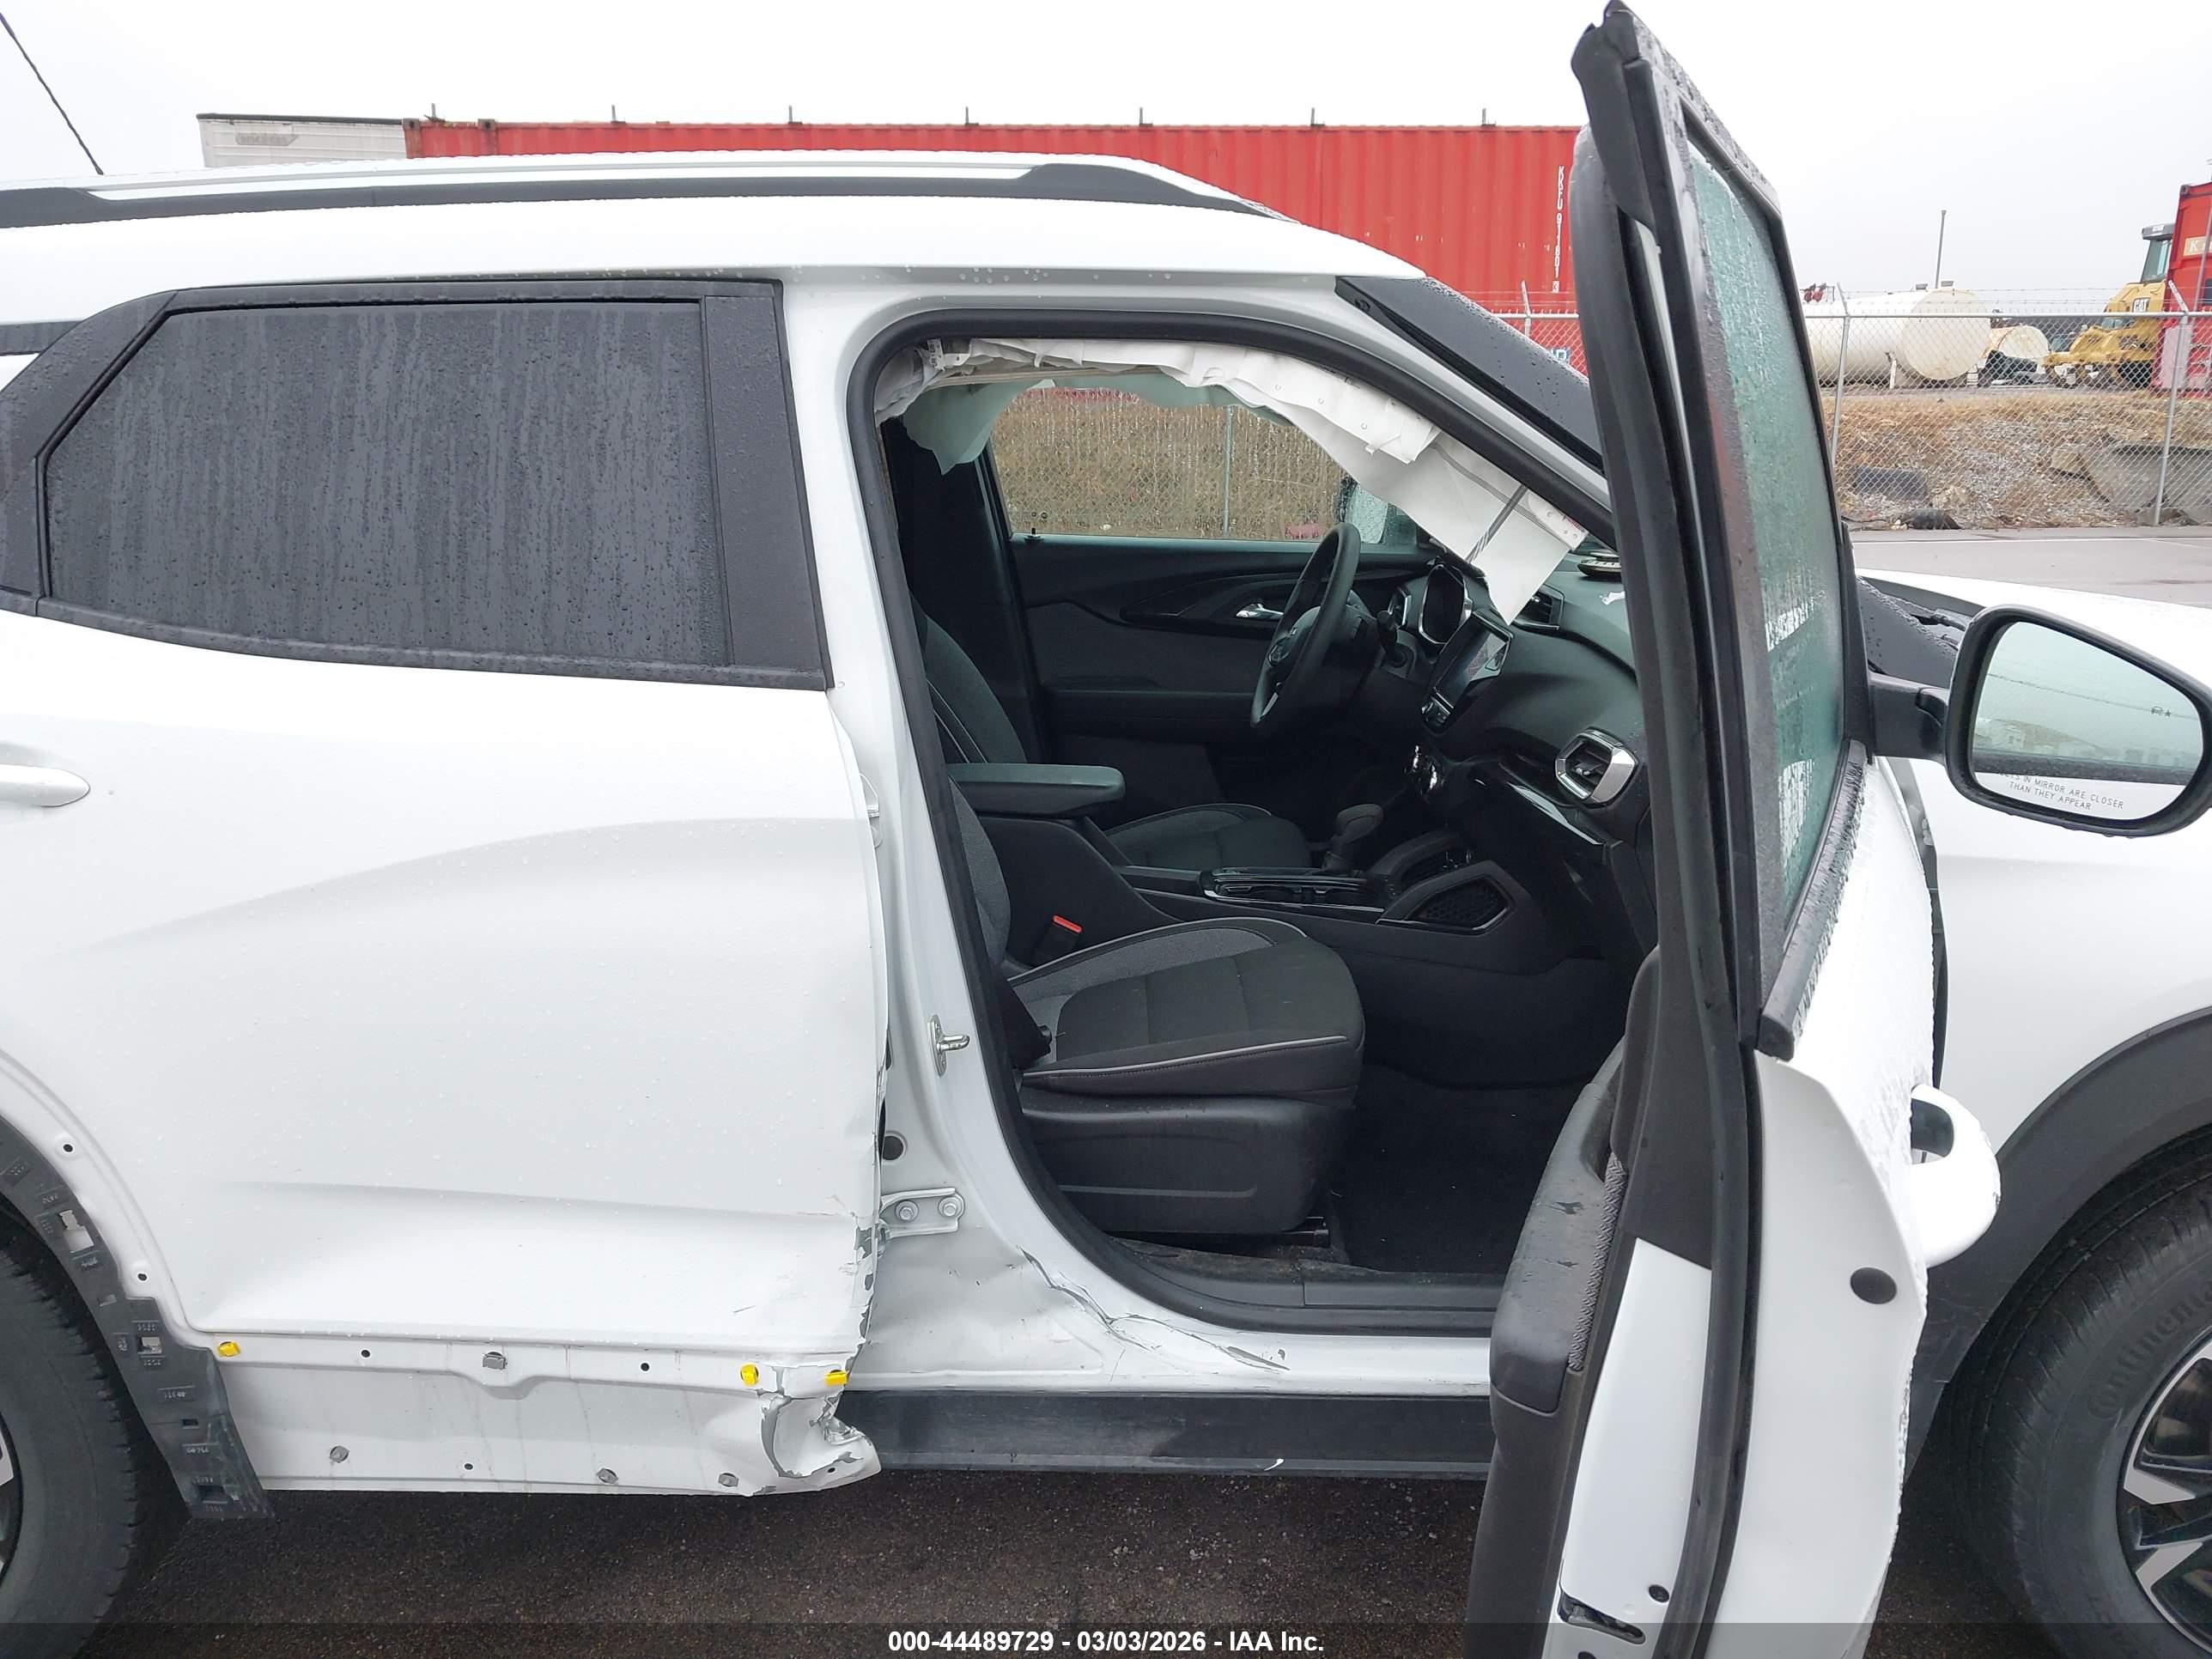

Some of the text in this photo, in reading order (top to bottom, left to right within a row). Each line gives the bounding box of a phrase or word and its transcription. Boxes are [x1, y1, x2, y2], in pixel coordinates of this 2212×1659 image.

[1557, 165, 1565, 210] KKFU
[2135, 298, 2148, 312] CAT
[2008, 781, 2092, 810] THAN THEY APPEAR
[2034, 778, 2066, 793] MIRROR
[2069, 789, 2086, 799] ARE
[2090, 794, 2124, 810] CLOSER
